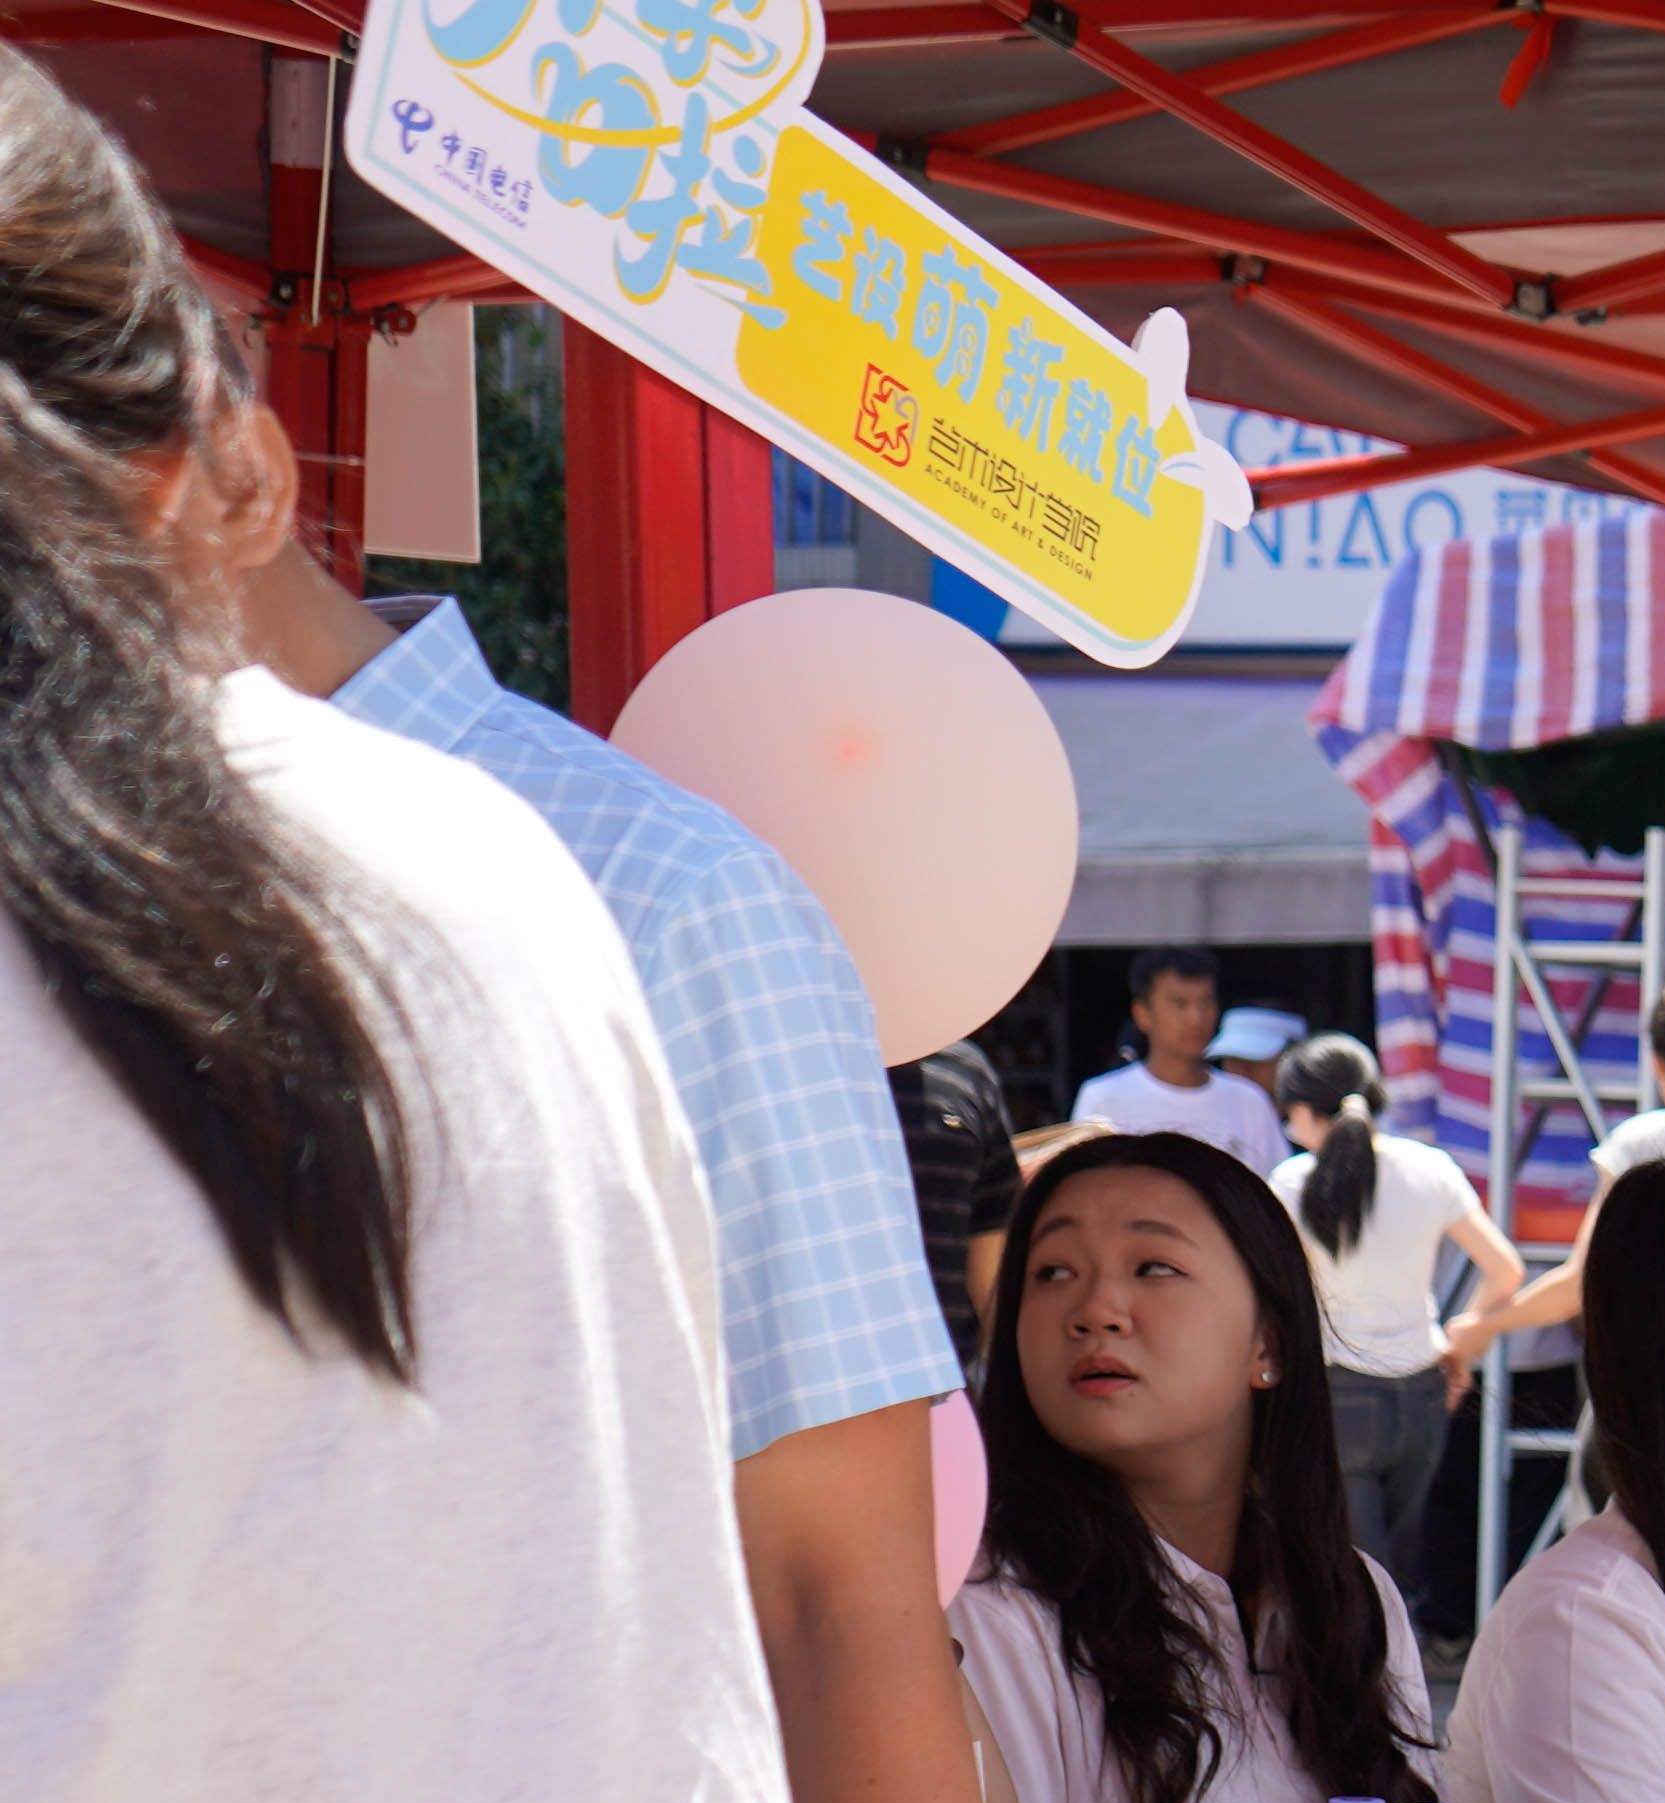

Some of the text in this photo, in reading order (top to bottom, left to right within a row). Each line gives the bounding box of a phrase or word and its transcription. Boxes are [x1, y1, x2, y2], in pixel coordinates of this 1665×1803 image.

[440, 129, 534, 213] 中国电信
[792, 188, 1164, 520] 艺设萌新就位
[924, 463, 987, 511] ACADEMY
[991, 506, 1008, 526] OF
[1011, 521, 1034, 541] ART
[1048, 545, 1094, 581] DESIGN
